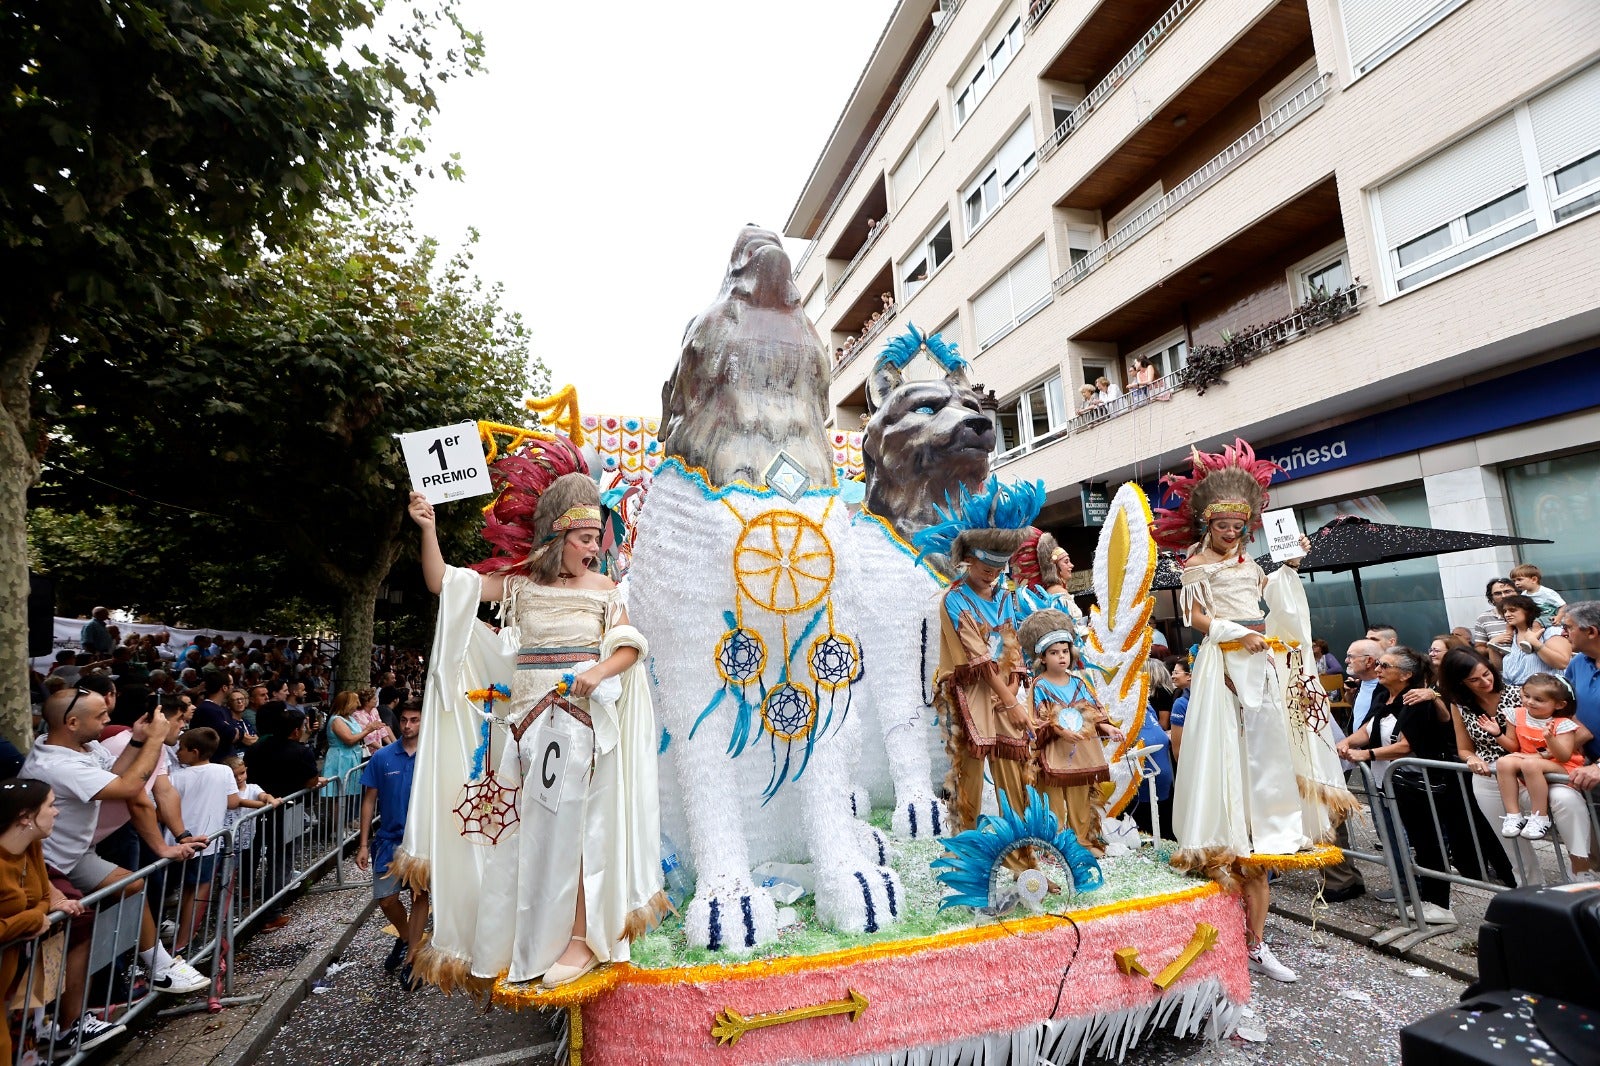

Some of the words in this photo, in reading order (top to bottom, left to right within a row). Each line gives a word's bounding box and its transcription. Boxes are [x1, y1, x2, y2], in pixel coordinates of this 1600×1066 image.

[428, 435, 460, 471] 1er
[1271, 440, 1347, 474] tañesa
[422, 467, 477, 488] PREMIO
[1274, 534, 1294, 543] PREMIO
[542, 741, 560, 789] C
